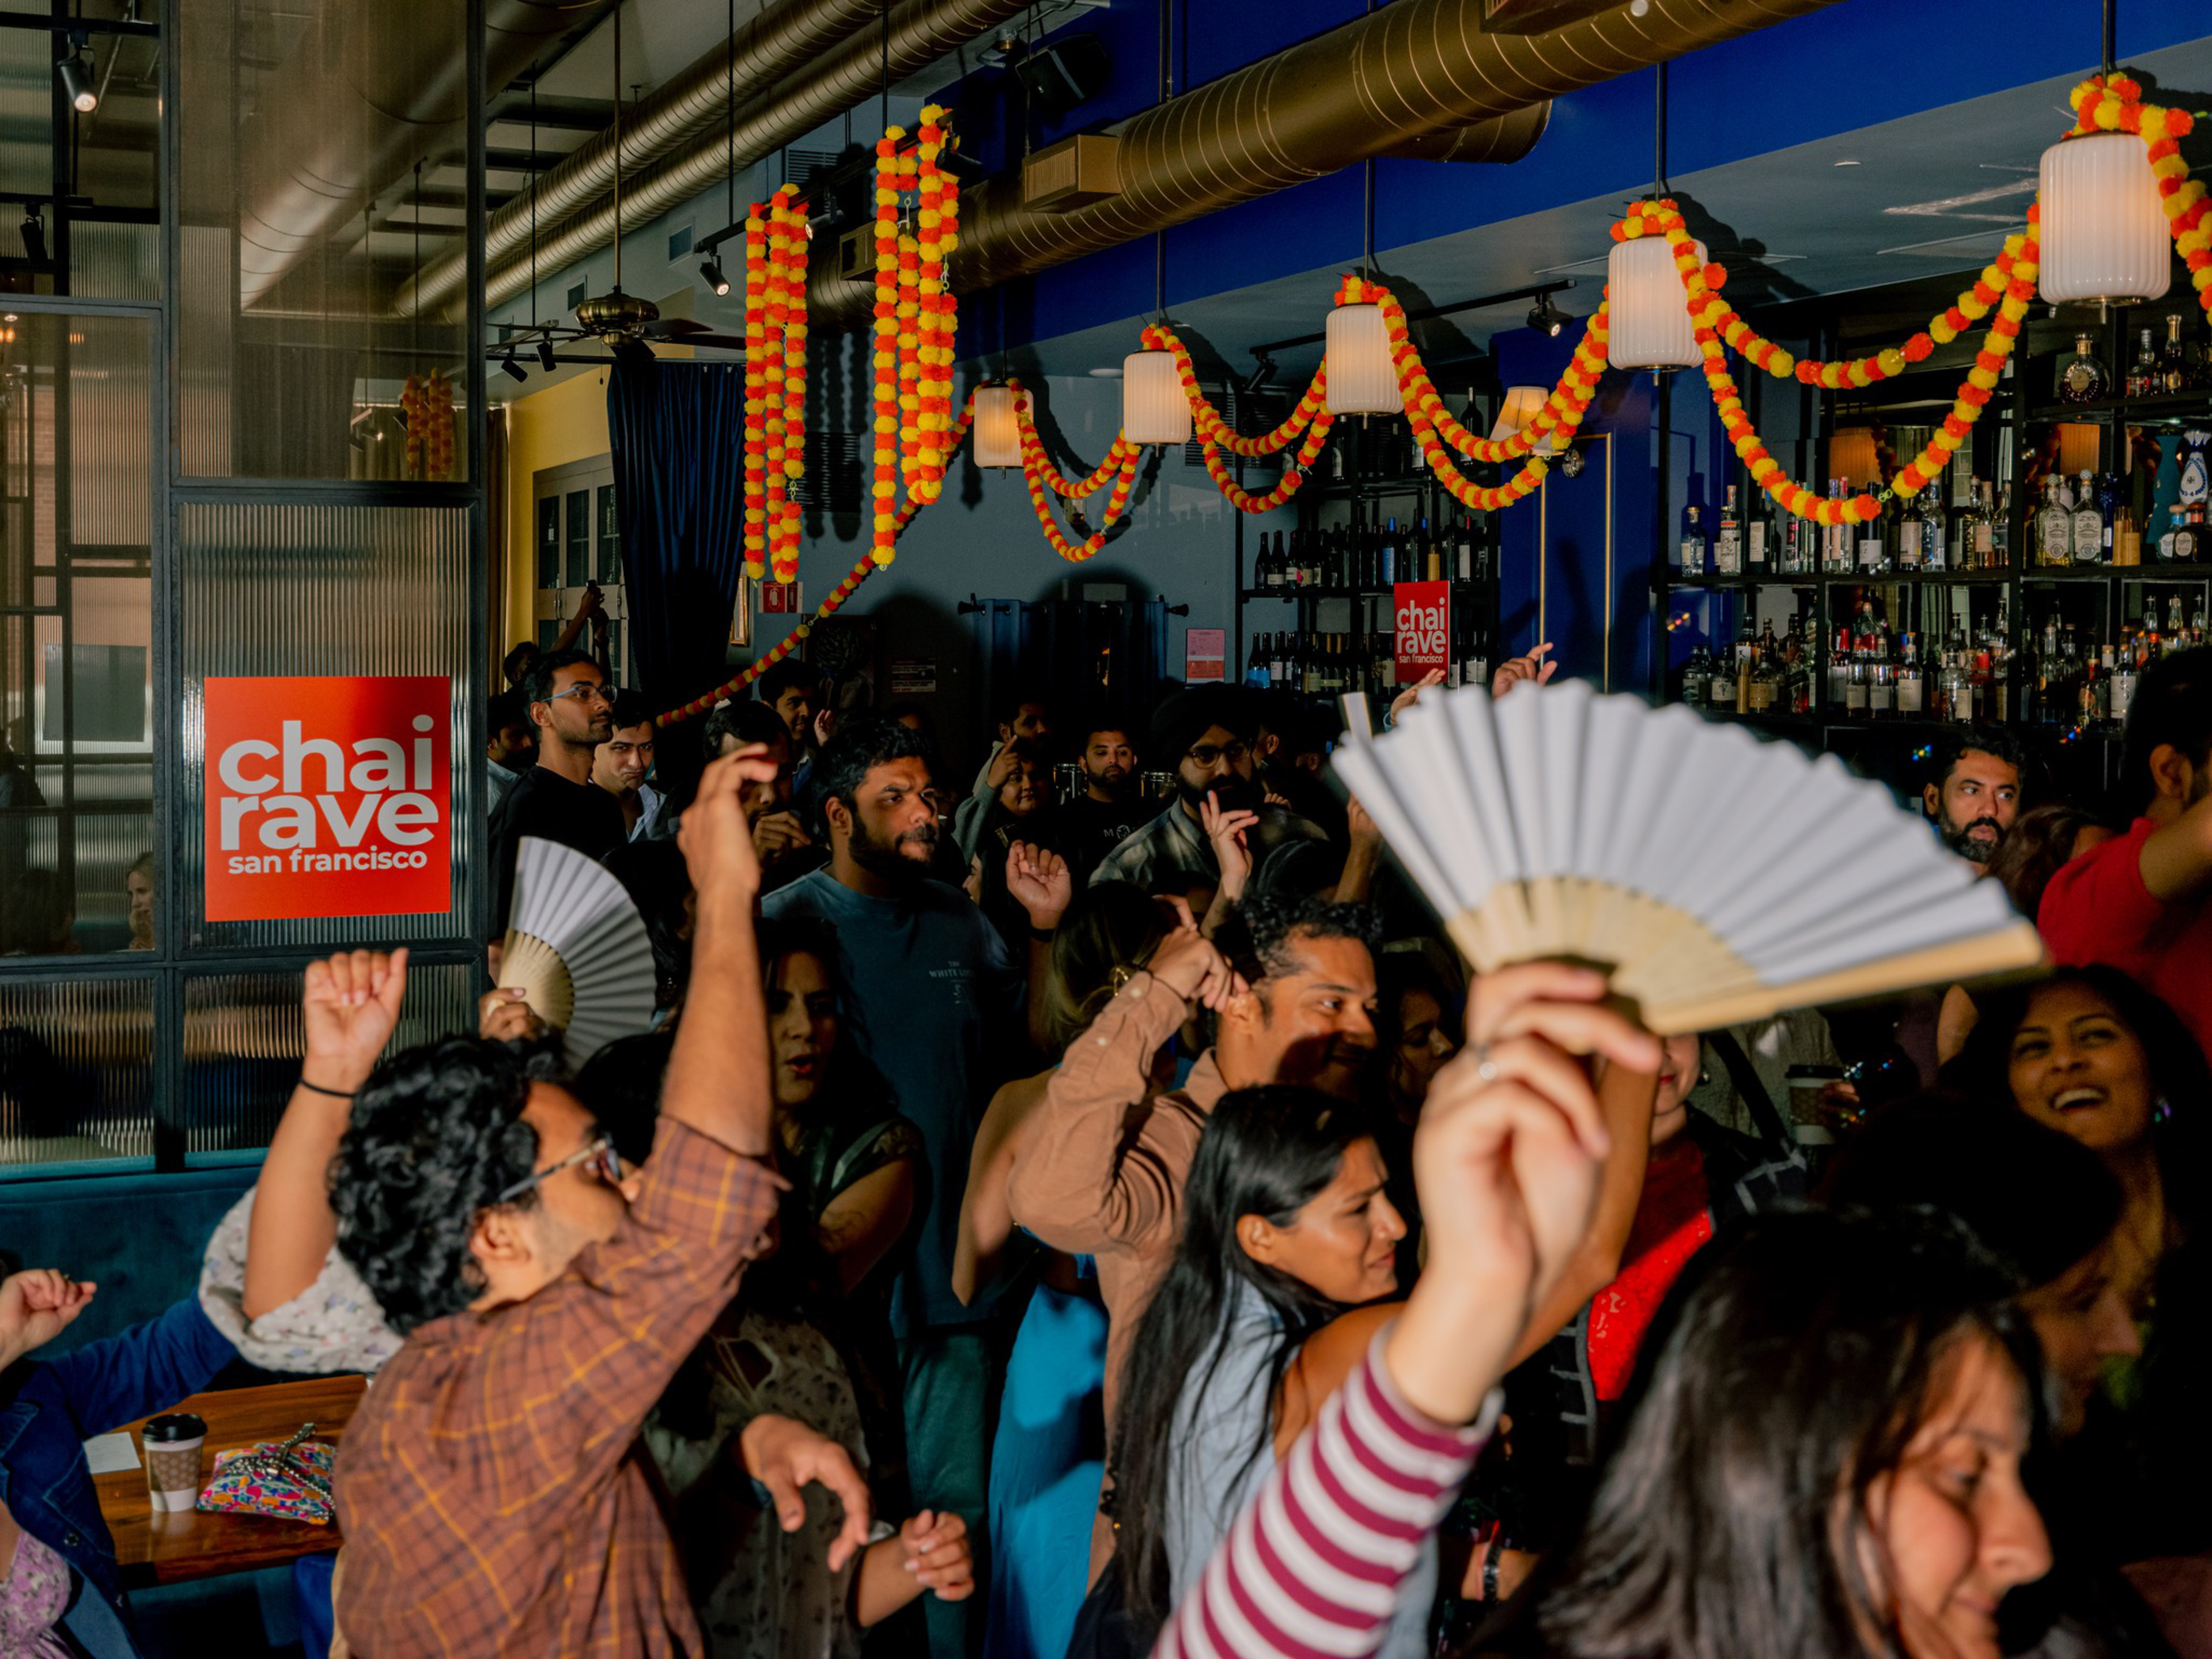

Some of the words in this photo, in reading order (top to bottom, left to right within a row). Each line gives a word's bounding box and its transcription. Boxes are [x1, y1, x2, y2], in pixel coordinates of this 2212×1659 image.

[1397, 597, 1445, 631] chai
[1397, 630, 1446, 654] rave
[1399, 656, 1411, 664] san
[1412, 653, 1443, 664] francisco
[218, 714, 434, 794] chai
[220, 792, 439, 851] rave
[228, 855, 281, 874] san
[290, 846, 428, 873] francisco
